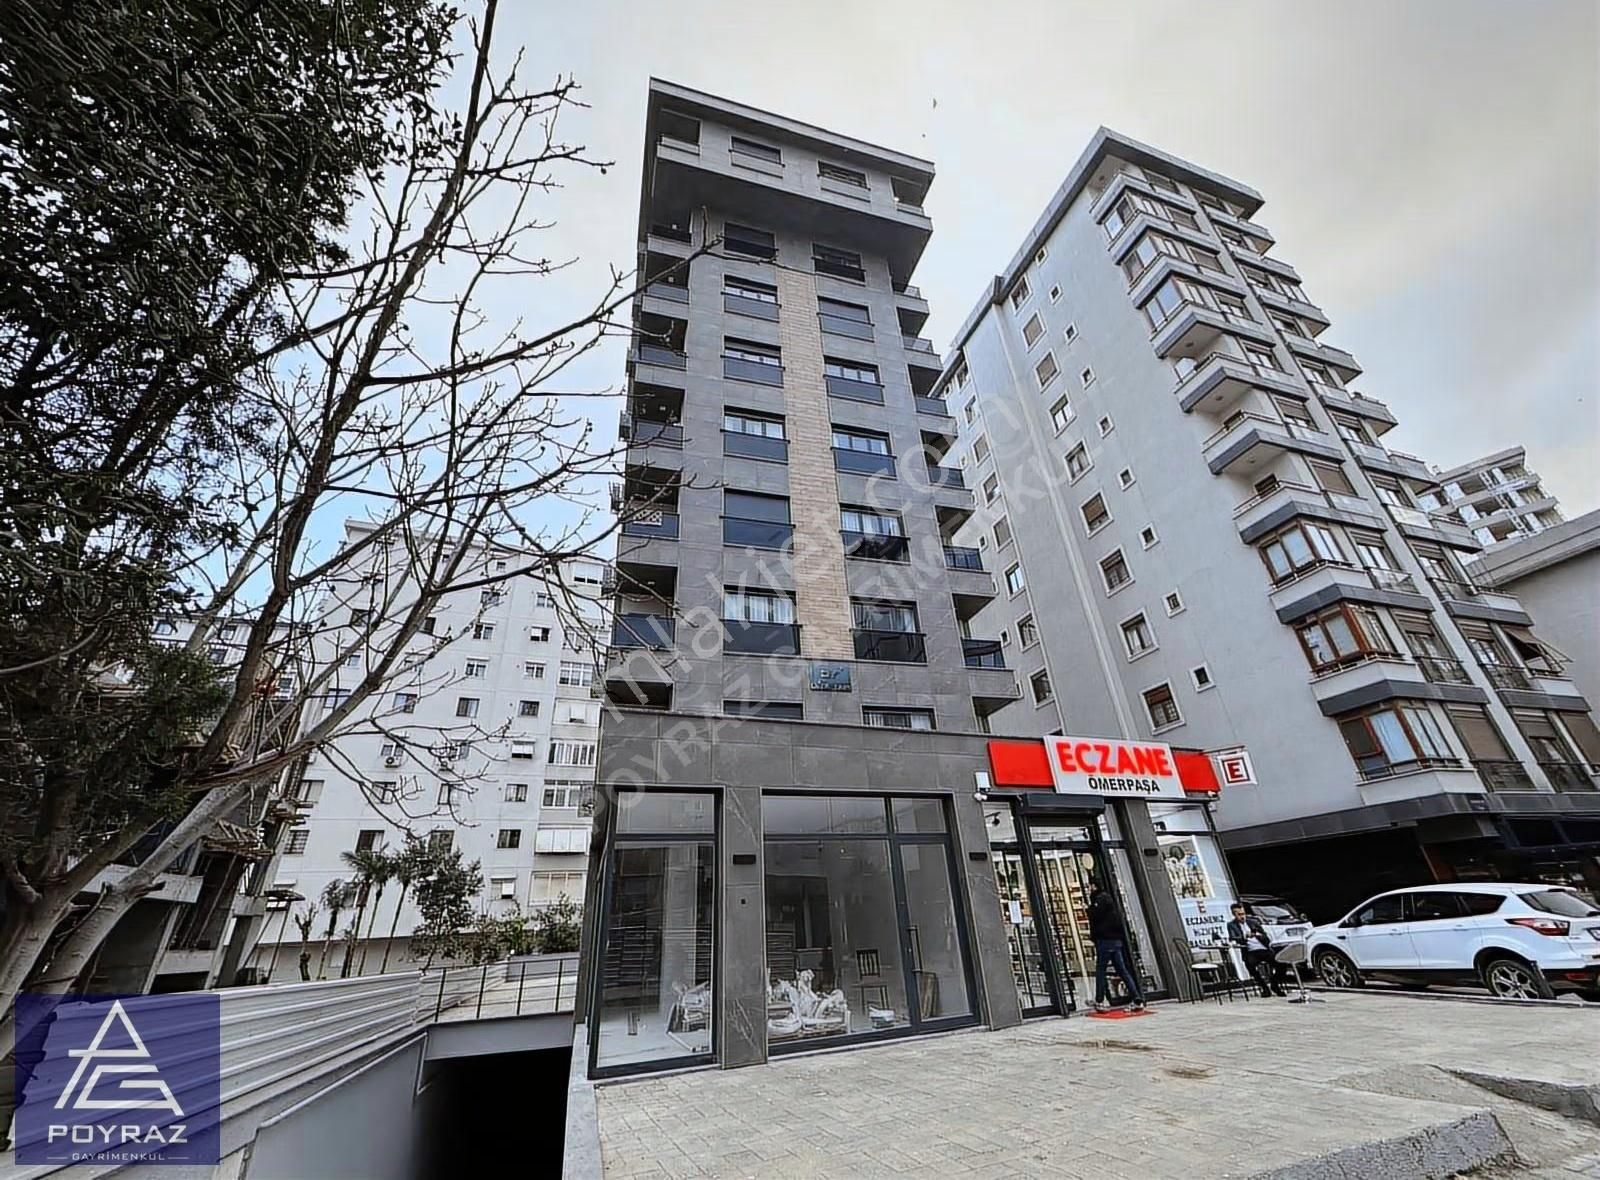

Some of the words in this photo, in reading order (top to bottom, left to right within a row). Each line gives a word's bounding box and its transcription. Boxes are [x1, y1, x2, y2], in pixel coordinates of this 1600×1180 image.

[1056, 742, 1173, 777] ECZANE
[1226, 761, 1244, 779] E
[1088, 774, 1161, 795] ÖMERPAŞA
